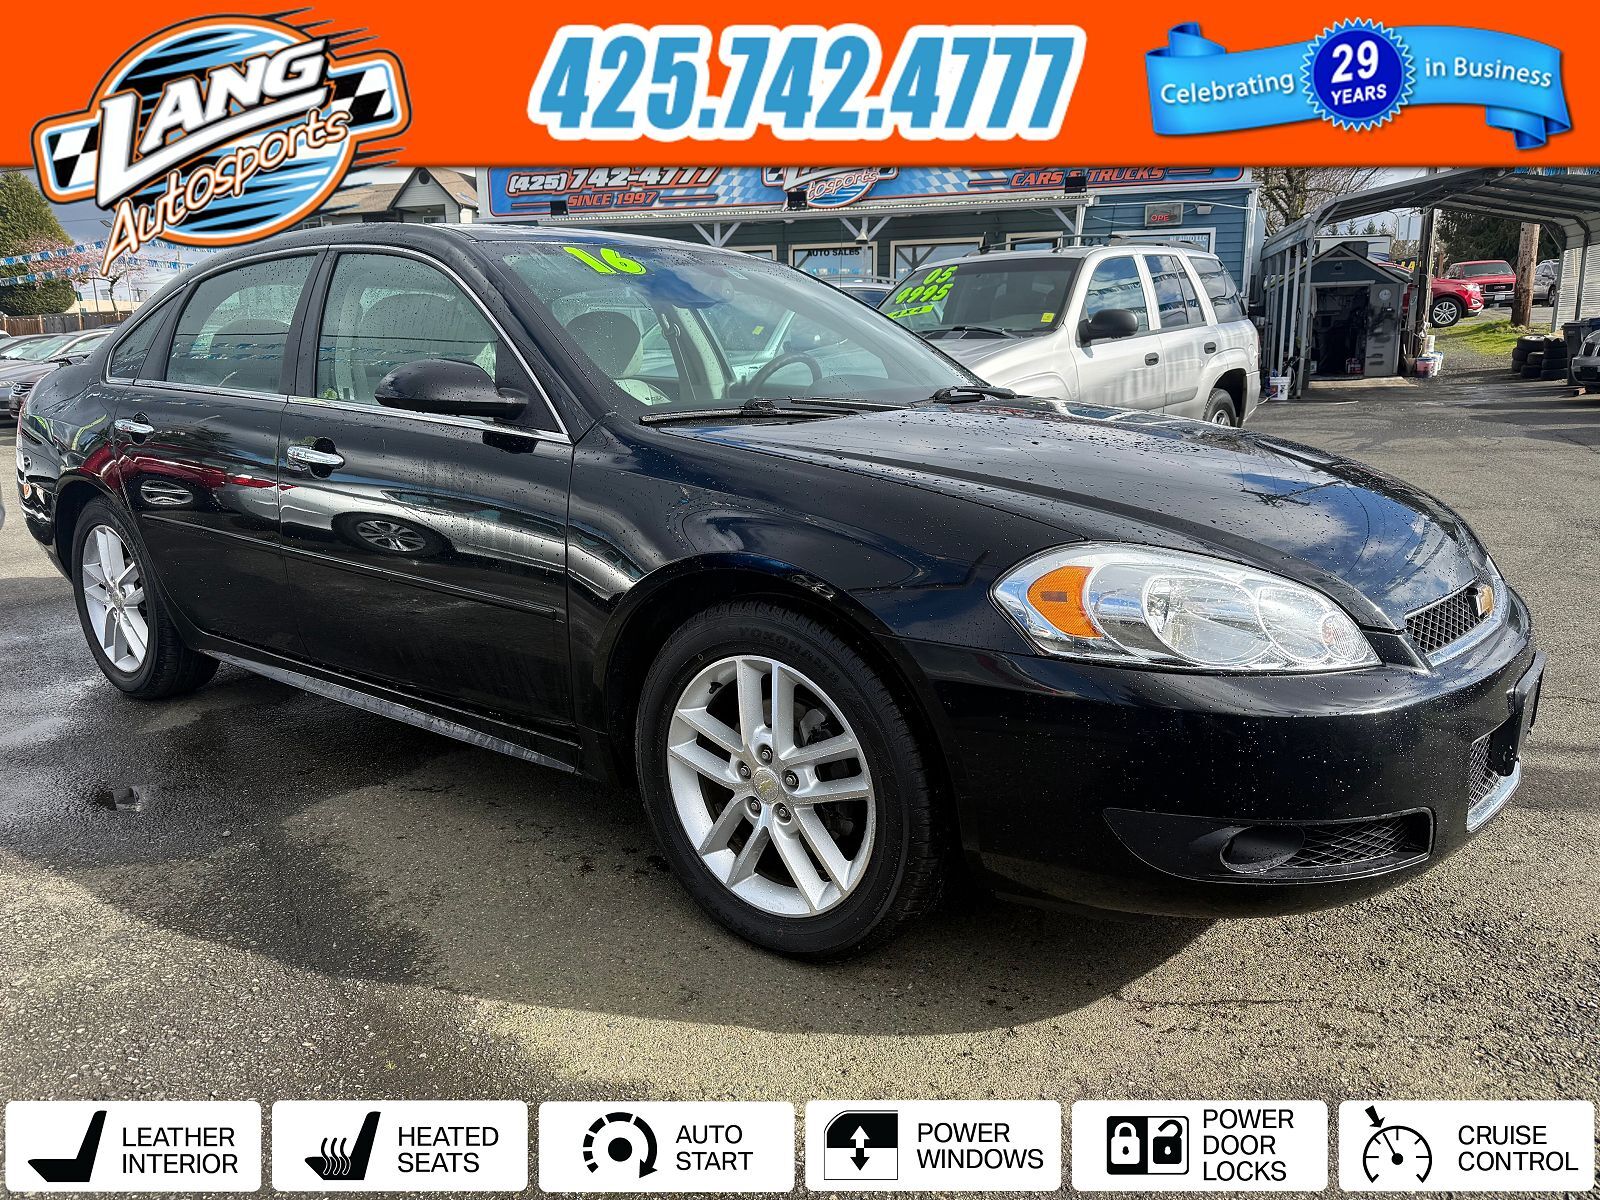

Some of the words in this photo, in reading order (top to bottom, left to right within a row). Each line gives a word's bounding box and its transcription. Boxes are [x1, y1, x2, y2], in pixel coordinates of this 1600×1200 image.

[509, 173, 568, 194] (425)
[570, 167, 714, 189] 742-4777
[795, 169, 879, 204] tosports
[1011, 172, 1063, 187] CARS
[1088, 167, 1165, 182] TRUCKS
[568, 193, 612, 207] SINCE
[616, 191, 656, 206] 1997
[563, 247, 646, 275] 16
[923, 265, 959, 285] 05
